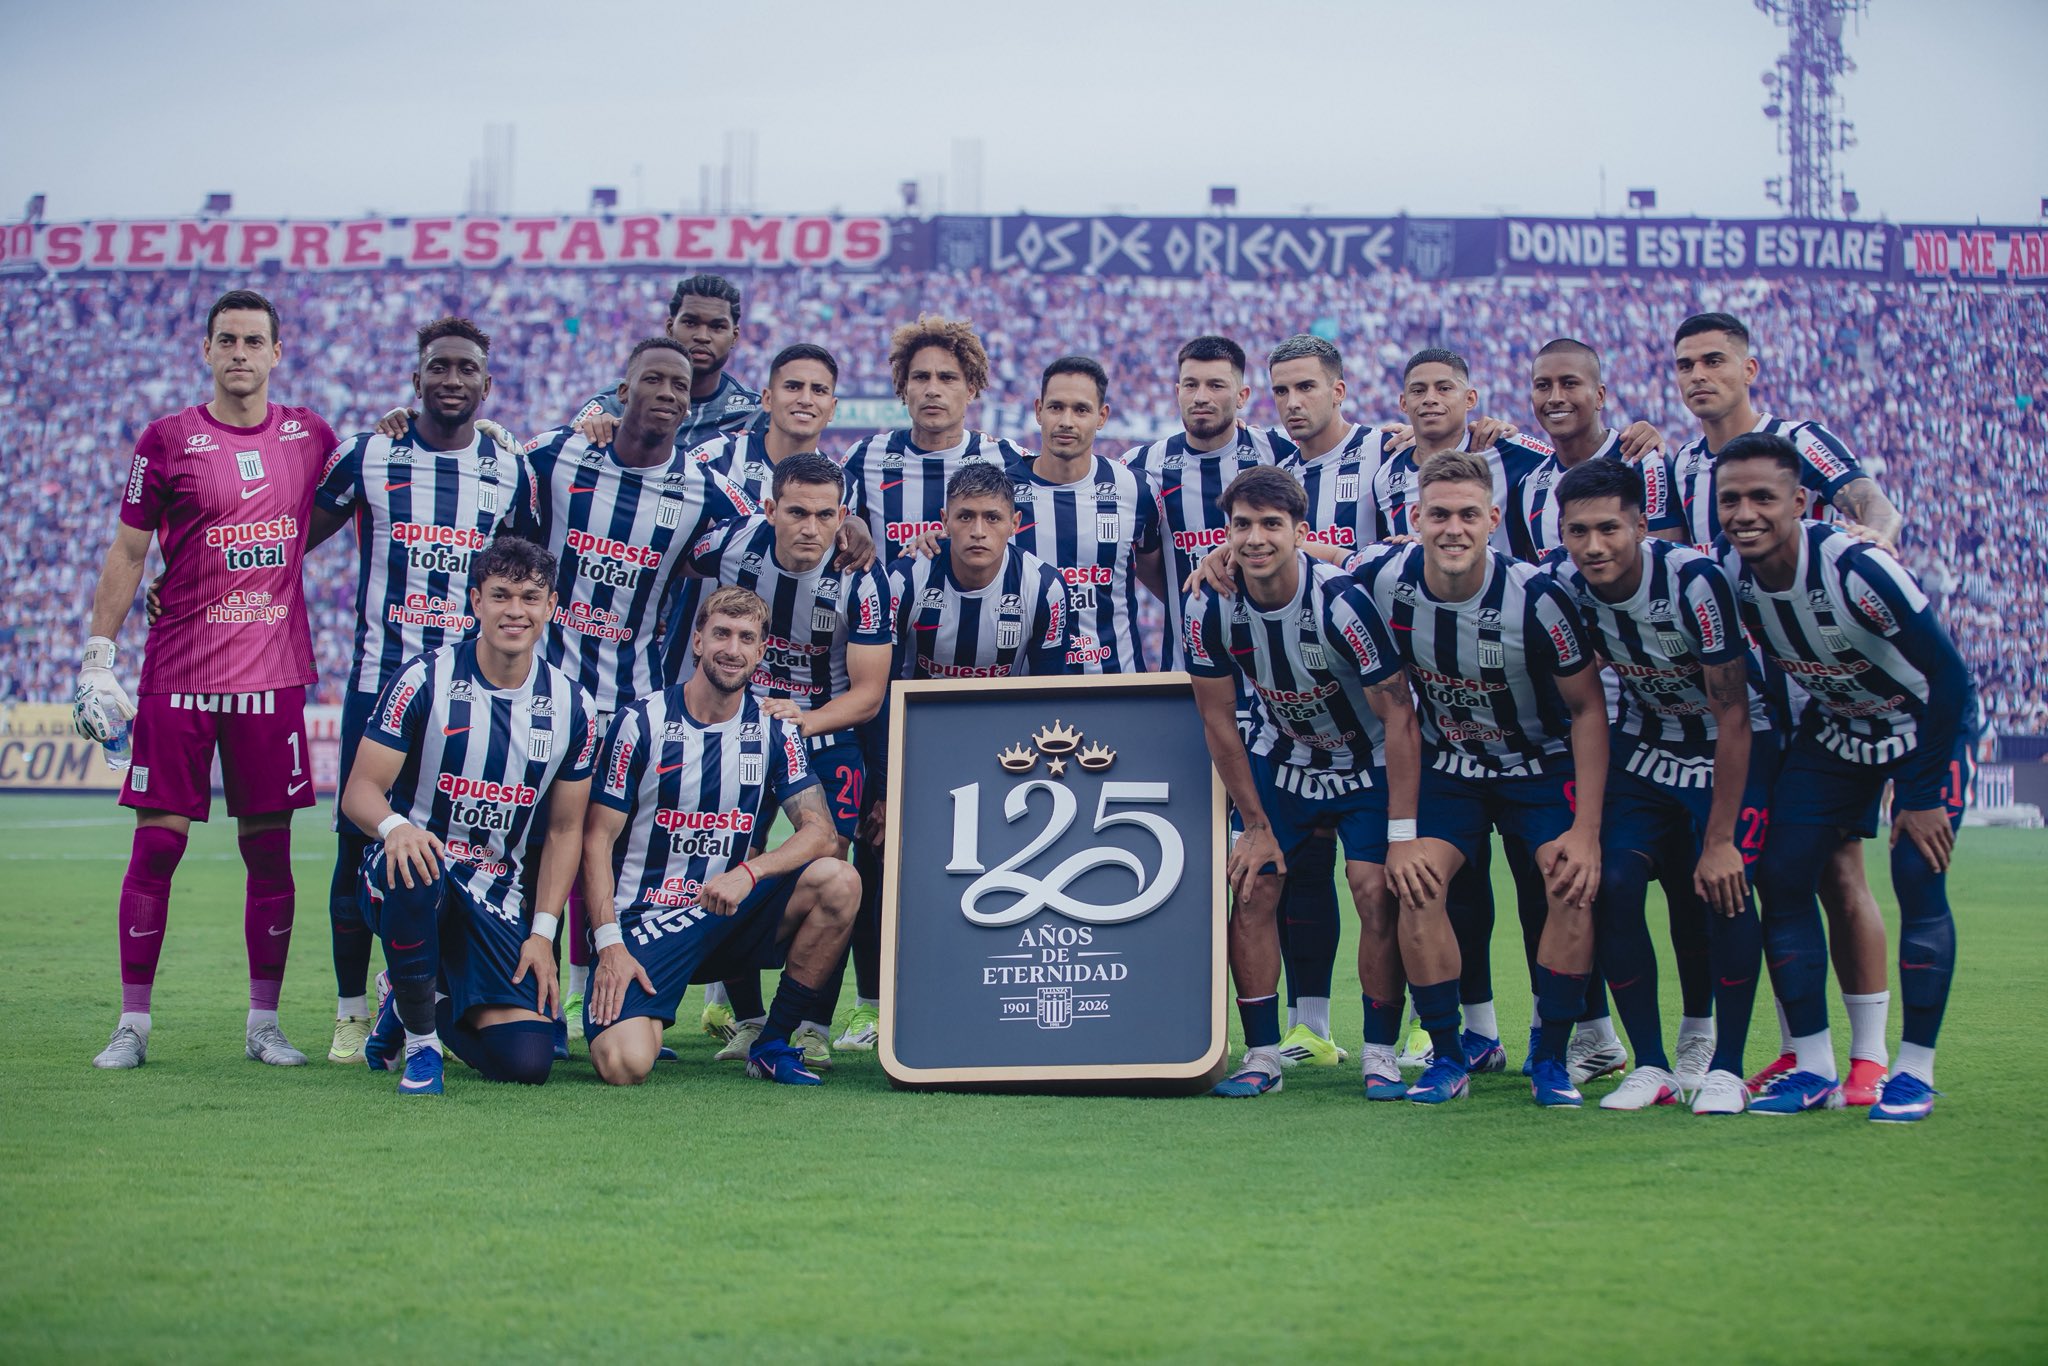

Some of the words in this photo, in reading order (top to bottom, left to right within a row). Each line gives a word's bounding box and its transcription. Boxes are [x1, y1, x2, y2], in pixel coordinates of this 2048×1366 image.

[46, 221, 383, 266] SIEMPRE
[410, 218, 884, 263] ESTAREMOS
[990, 217, 1081, 271] LOS
[1090, 220, 1152, 271] DE
[1164, 222, 1395, 276] ORIENTE
[1508, 221, 1627, 266] DONDE
[1636, 220, 1747, 268] ESTÉS
[1756, 222, 1886, 271] ESTARÉ
[1913, 233, 1949, 274] NO
[1958, 233, 1996, 275] ME
[184, 444, 220, 454] HYUNDAI
[279, 430, 310, 442] HYUNDAI
[126, 454, 141, 503] LOTERIAS
[131, 456, 149, 505] TORITO
[473, 467, 503, 476] HYUNDAI
[657, 483, 689, 491] HYUNDAI
[1646, 468, 1657, 514] TORITO
[207, 515, 297, 549] apuesta
[392, 523, 485, 550] apuesta
[887, 522, 943, 545] apue
[1174, 530, 1227, 552] apue
[227, 543, 285, 570] total
[409, 548, 468, 573] total
[567, 529, 662, 568] apuesta
[579, 557, 637, 589] total
[736, 560, 764, 576] HYUNDAI
[1060, 565, 1113, 585] esta
[430, 597, 457, 613] Caja
[916, 601, 948, 609] HYUNDAI
[1070, 589, 1096, 610] tal
[207, 605, 288, 625] Huancayo
[388, 605, 475, 632] Huancayo
[555, 607, 633, 643] Huancayo
[592, 608, 619, 623] Caja
[1470, 621, 1506, 631] HYUNDAI
[1697, 604, 1714, 647] TORITO
[1706, 599, 1725, 645] LOTERIAS
[1342, 626, 1371, 667] TORITO
[1352, 619, 1378, 664] LOTERIAS
[764, 649, 810, 667] otal
[918, 654, 1012, 677] apuesta
[1066, 647, 1111, 666] ncayo
[752, 675, 823, 696] uancayo
[1426, 683, 1493, 709] total
[384, 680, 406, 726] LOTERIAS
[391, 686, 415, 730] TORITO
[526, 707, 557, 716] HYUNDAI
[0, 741, 94, 781] COM
[287, 732, 303, 777] 1
[607, 738, 623, 788] LOTERIAS
[615, 743, 633, 789] TORITO
[1625, 742, 1715, 788] ilum
[438, 773, 537, 806] apuesta
[836, 764, 863, 809] 20
[453, 801, 512, 830] total
[655, 808, 754, 834] apuesta
[671, 833, 731, 858] total
[945, 780, 1185, 927] 125
[1018, 924, 1093, 948] AÑOS
[1041, 949, 1070, 963] DE
[982, 963, 1128, 985] ETERNIDAD
[1002, 1002, 1031, 1014] 1901
[1077, 1000, 1109, 1012] 2026
